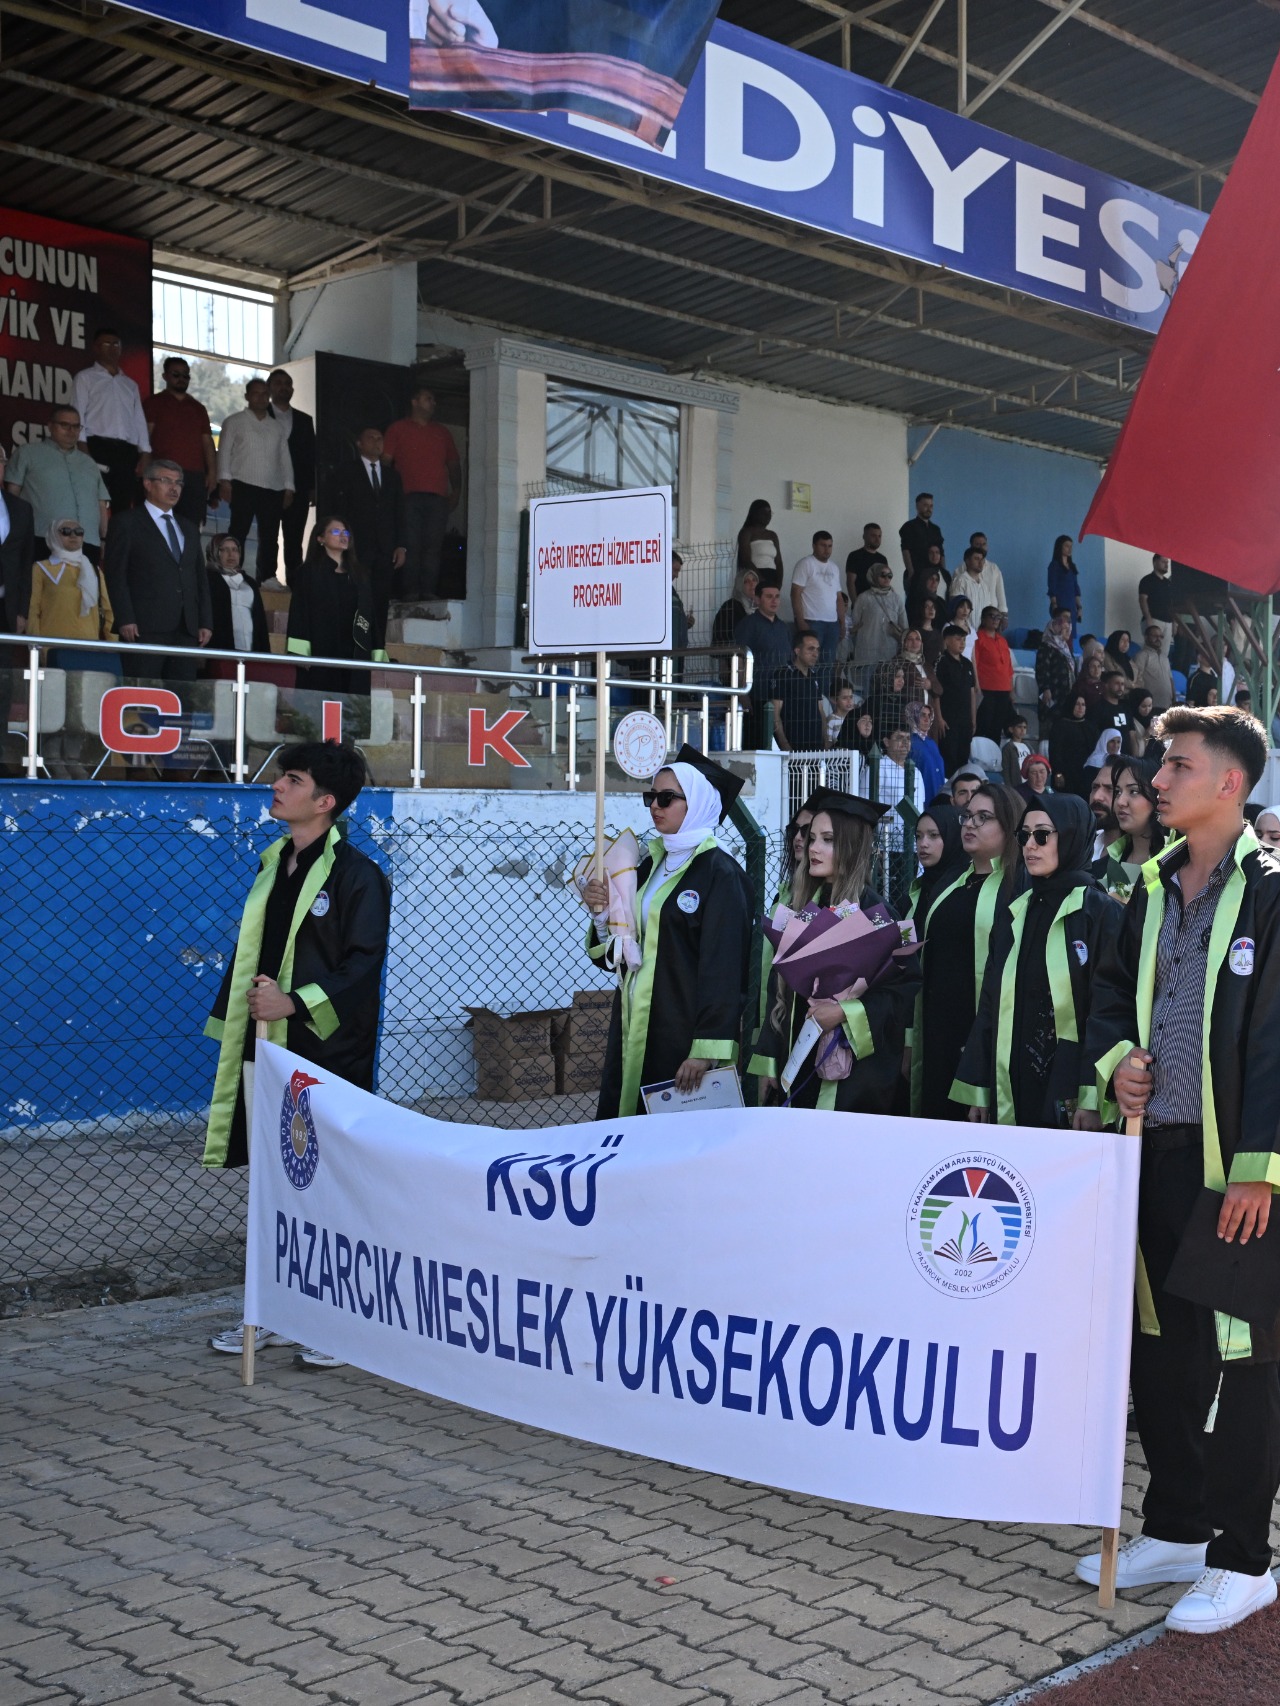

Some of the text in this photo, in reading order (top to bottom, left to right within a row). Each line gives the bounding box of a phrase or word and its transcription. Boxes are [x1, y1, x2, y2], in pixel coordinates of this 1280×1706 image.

[49, 306, 85, 350] VE
[538, 533, 661, 576] ÇAĞRI MERKEZİ HİZMETLERİ
[573, 583, 622, 608] PROGRAMI
[292, 1128, 307, 1142] 1992
[486, 1134, 624, 1227] KSÜ
[915, 1156, 971, 1207] KAHRAMANMARAŞ
[972, 1155, 996, 1167] SÜTÇÜ
[997, 1162, 1016, 1182] İMAM
[1015, 1180, 1032, 1238] ÜNİVERSİTESİ
[916, 1251, 1020, 1293] PAZARCIK MESLEK YÜKSEKOKULU
[954, 1268, 973, 1278] 2002
[276, 1209, 1037, 1452] PAZARCIK MESLEK YÜKSEKOKULU
